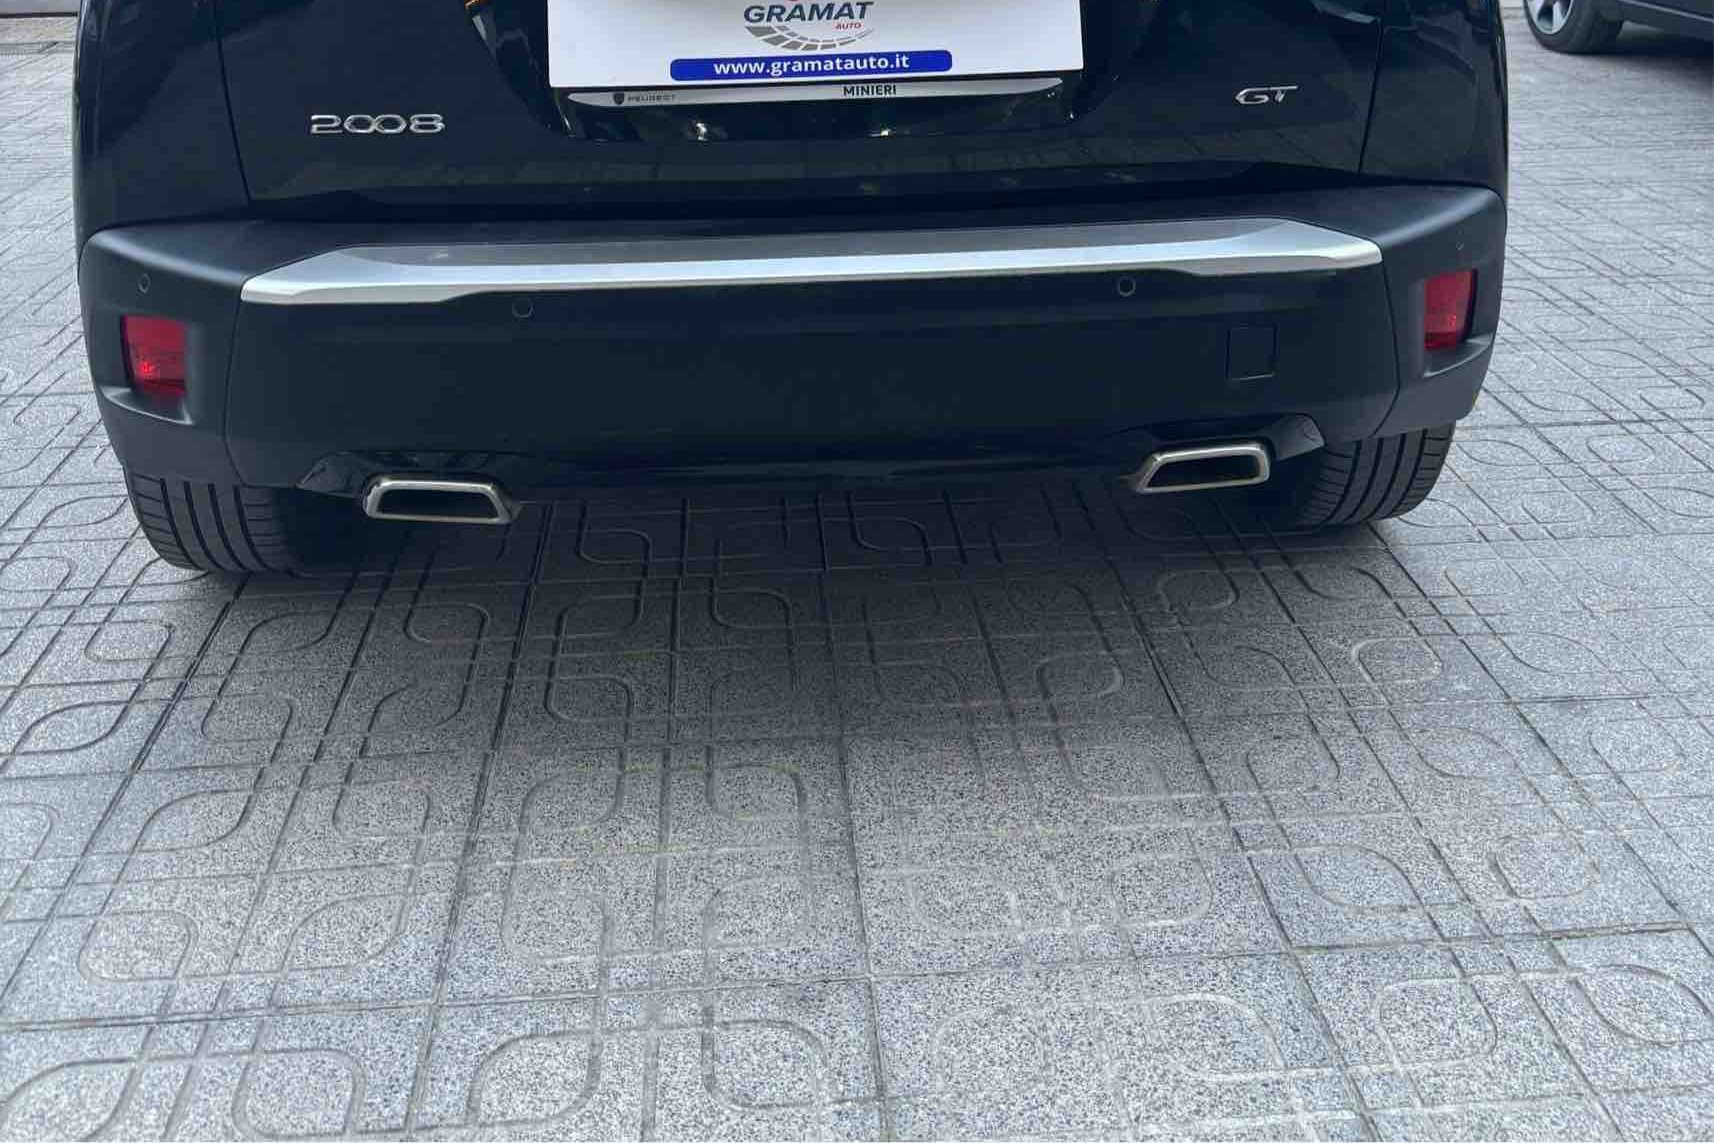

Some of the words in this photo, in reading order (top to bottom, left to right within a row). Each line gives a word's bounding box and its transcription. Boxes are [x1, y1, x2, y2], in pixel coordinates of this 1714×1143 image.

[743, 1, 875, 24] GRAMAT
[834, 21, 862, 31] AUTO
[713, 53, 911, 76] www.gramatauto.it
[843, 84, 897, 97] MINIERI
[1235, 85, 1299, 105] GT
[310, 114, 446, 134] 2008
